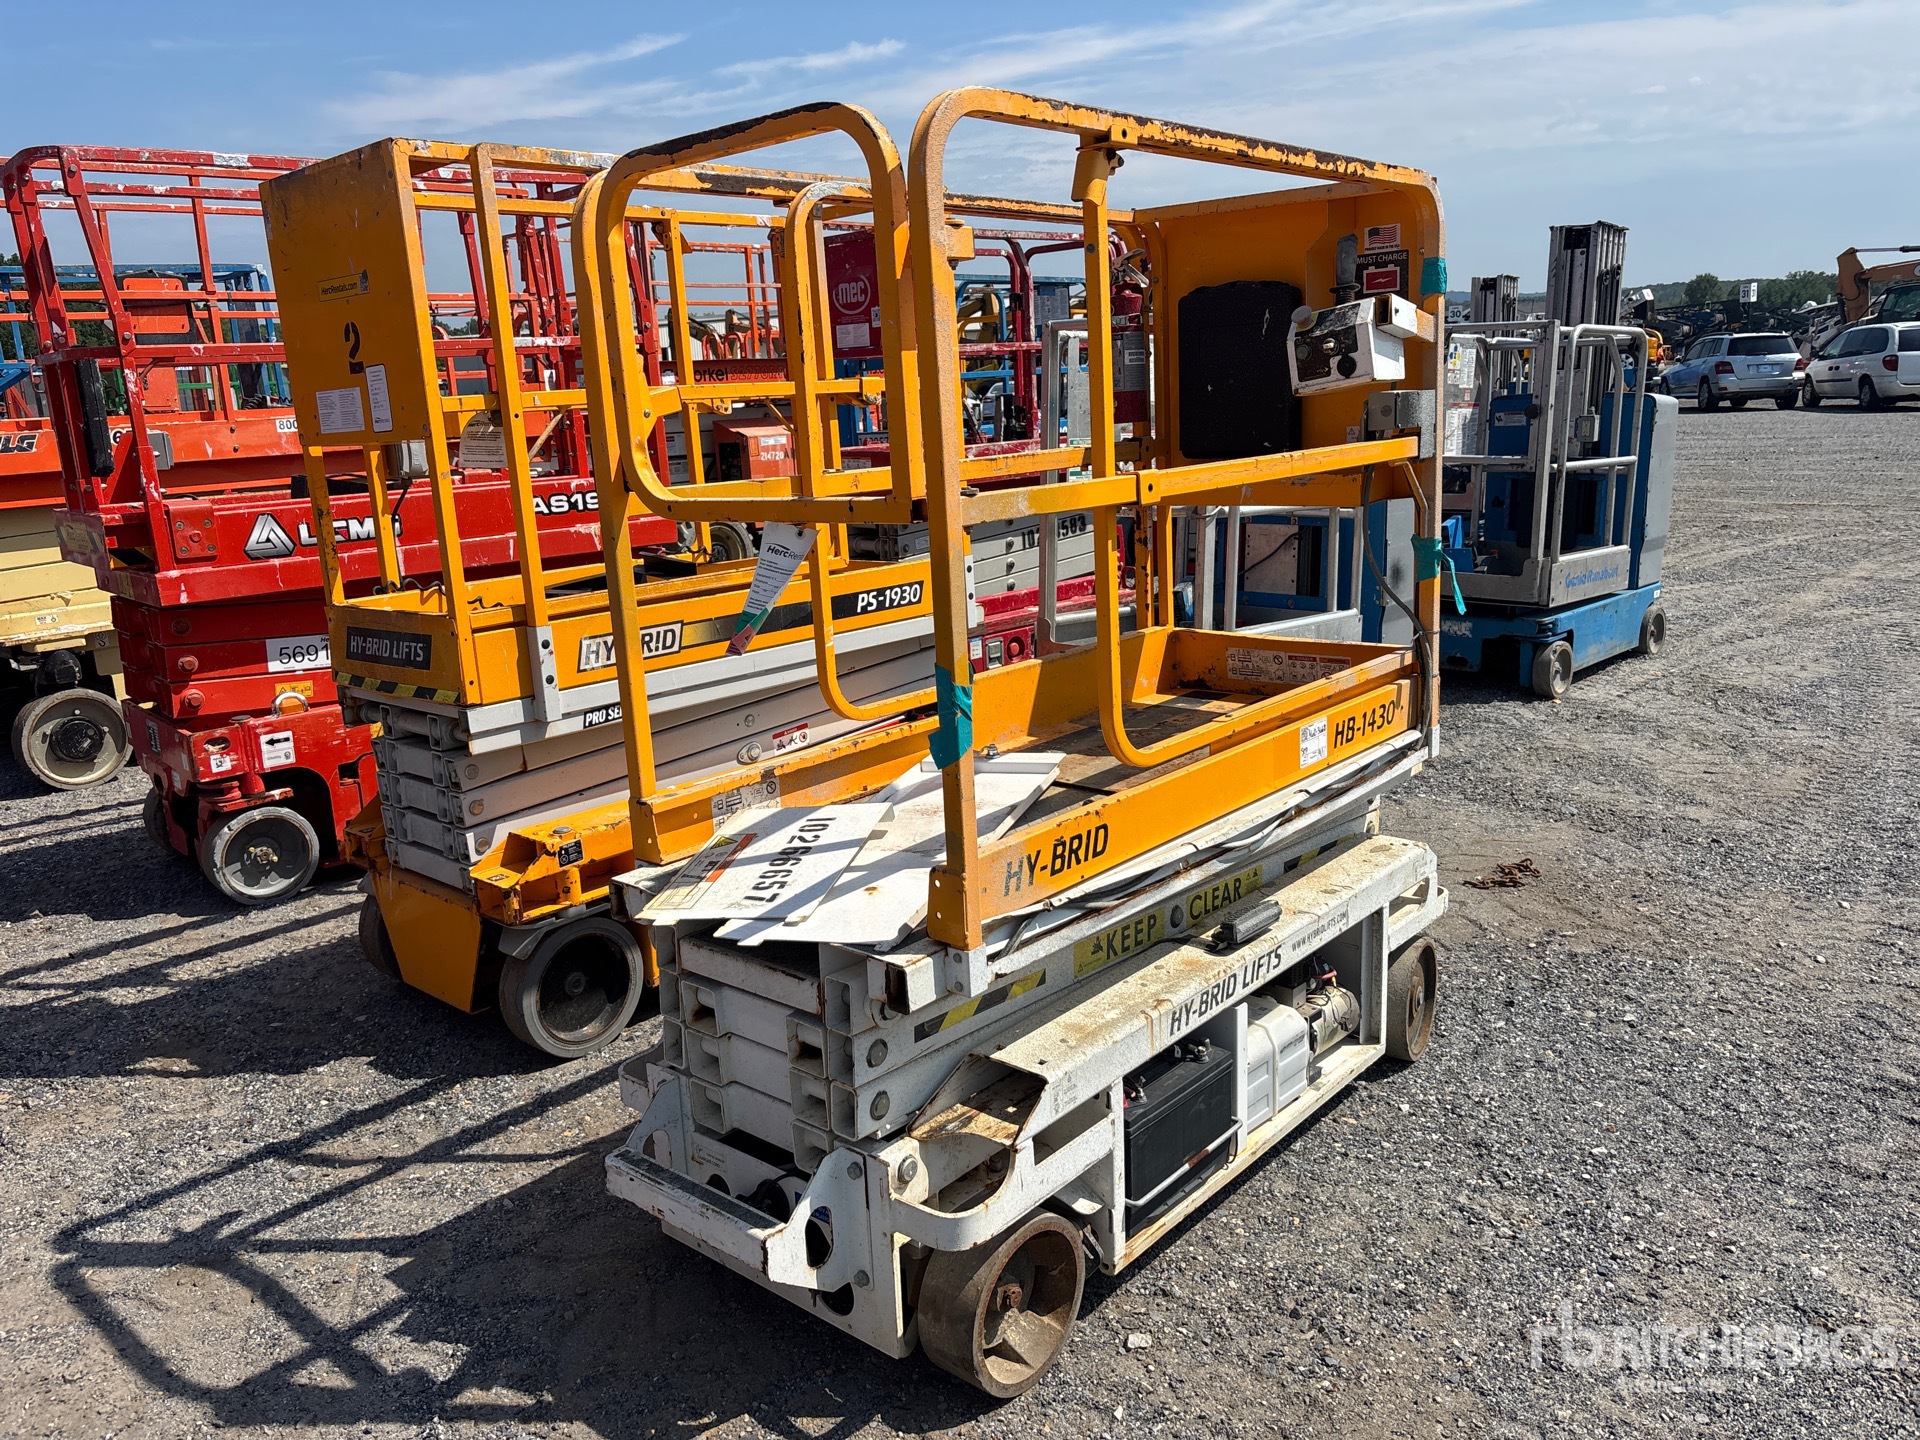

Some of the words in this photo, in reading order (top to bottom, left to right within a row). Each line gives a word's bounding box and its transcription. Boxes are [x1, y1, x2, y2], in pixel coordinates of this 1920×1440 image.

[1357, 256, 1377, 264] MUST
[1378, 252, 1407, 262] CHARGE
[321, 282, 357, 295] HercRentals.com
[1741, 290, 1749, 298] 31
[1450, 310, 1462, 318] 30
[344, 321, 364, 374] 2
[857, 584, 920, 613] PS-1930
[350, 635, 390, 657] HY-BRID
[392, 641, 424, 661] LIFTS
[585, 708, 606, 726] PRO
[608, 705, 622, 720] SE
[1334, 698, 1396, 749] HB-1430
[743, 817, 837, 903] 10266657
[1004, 823, 1109, 897] HY-BRID
[1106, 913, 1157, 960] KEEP
[1190, 878, 1242, 920] CLEAR
[1170, 973, 1237, 1037] HY-BRID
[1242, 945, 1282, 989] LIFTS
